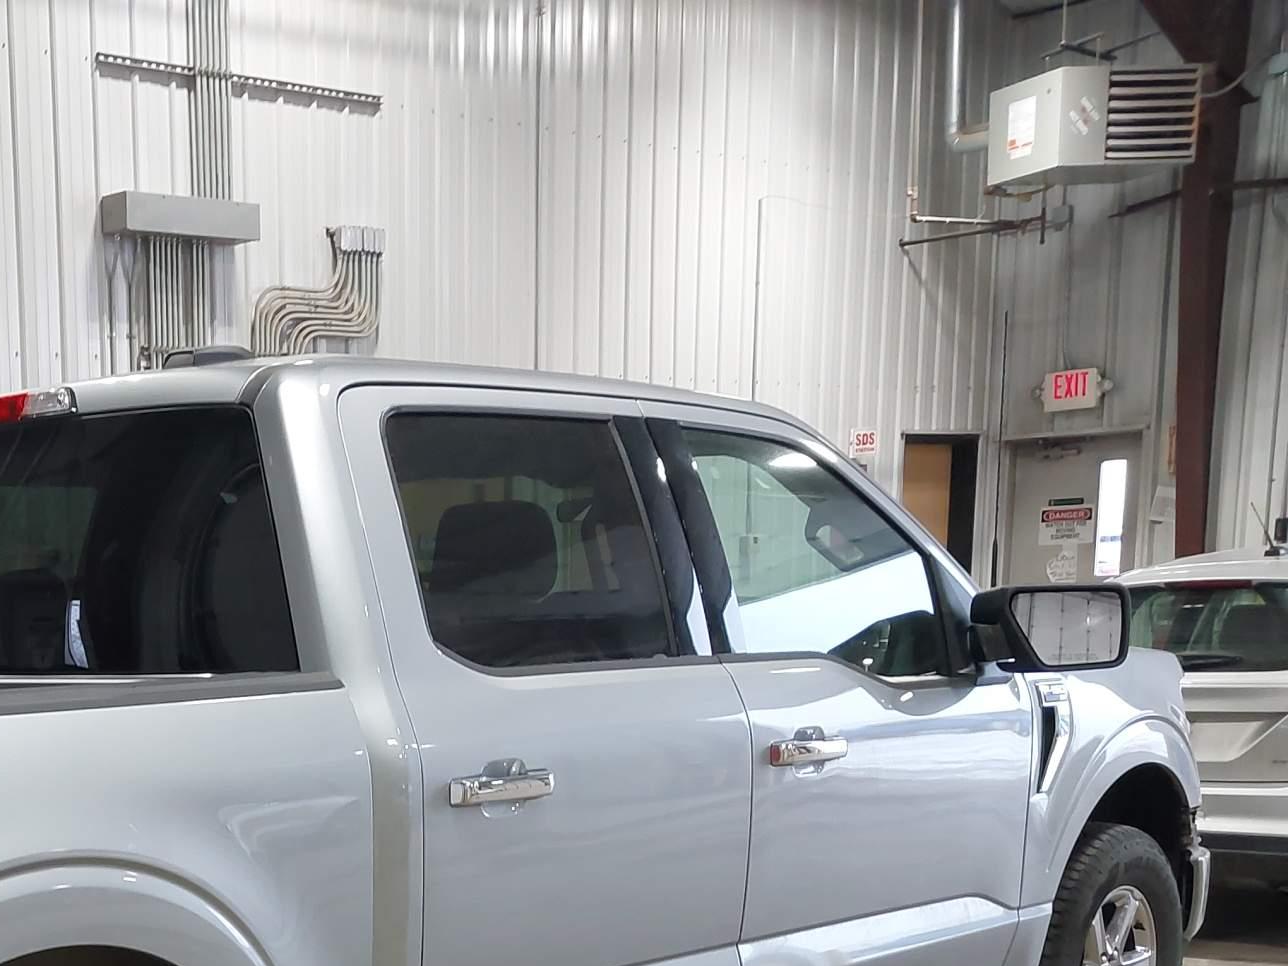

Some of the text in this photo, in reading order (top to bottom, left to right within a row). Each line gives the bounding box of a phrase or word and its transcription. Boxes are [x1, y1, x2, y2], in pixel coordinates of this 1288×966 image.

[1053, 371, 1089, 400] EXIT
[855, 432, 875, 447] SDS
[1048, 510, 1085, 521] DANGER
